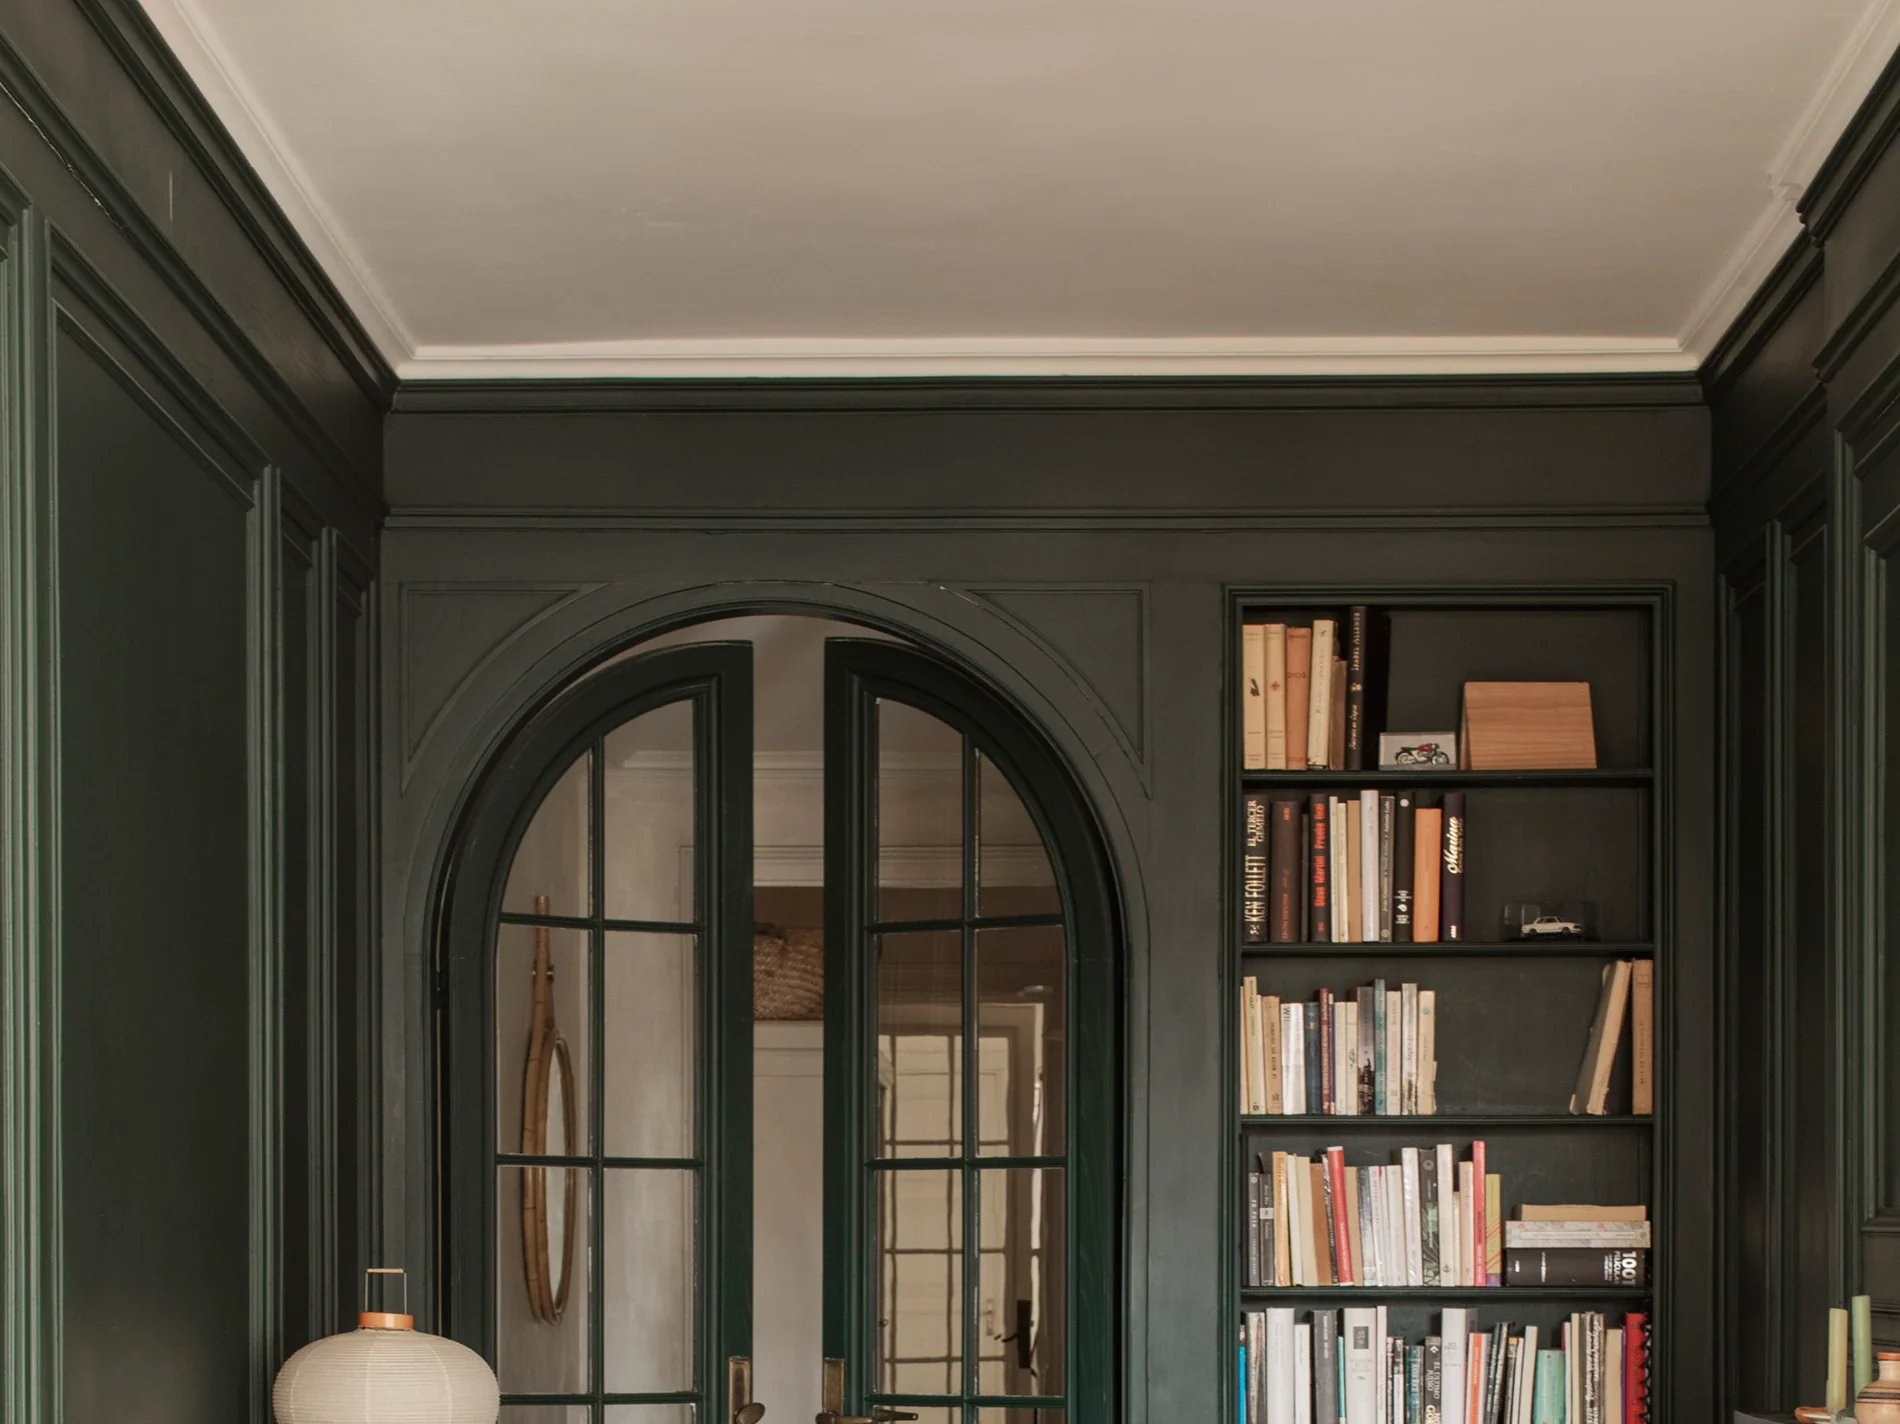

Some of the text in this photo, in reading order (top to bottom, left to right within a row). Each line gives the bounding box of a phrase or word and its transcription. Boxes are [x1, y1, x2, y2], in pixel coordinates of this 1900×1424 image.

[1351, 612, 1361, 646] ALLENDE
[1247, 799, 1258, 847] EL TERCER
[1256, 804, 1266, 843] GEMELO
[1445, 816, 1458, 874] Marina
[1244, 854, 1267, 922] KEN FOLLETT
[1621, 1250, 1637, 1285] 1001
